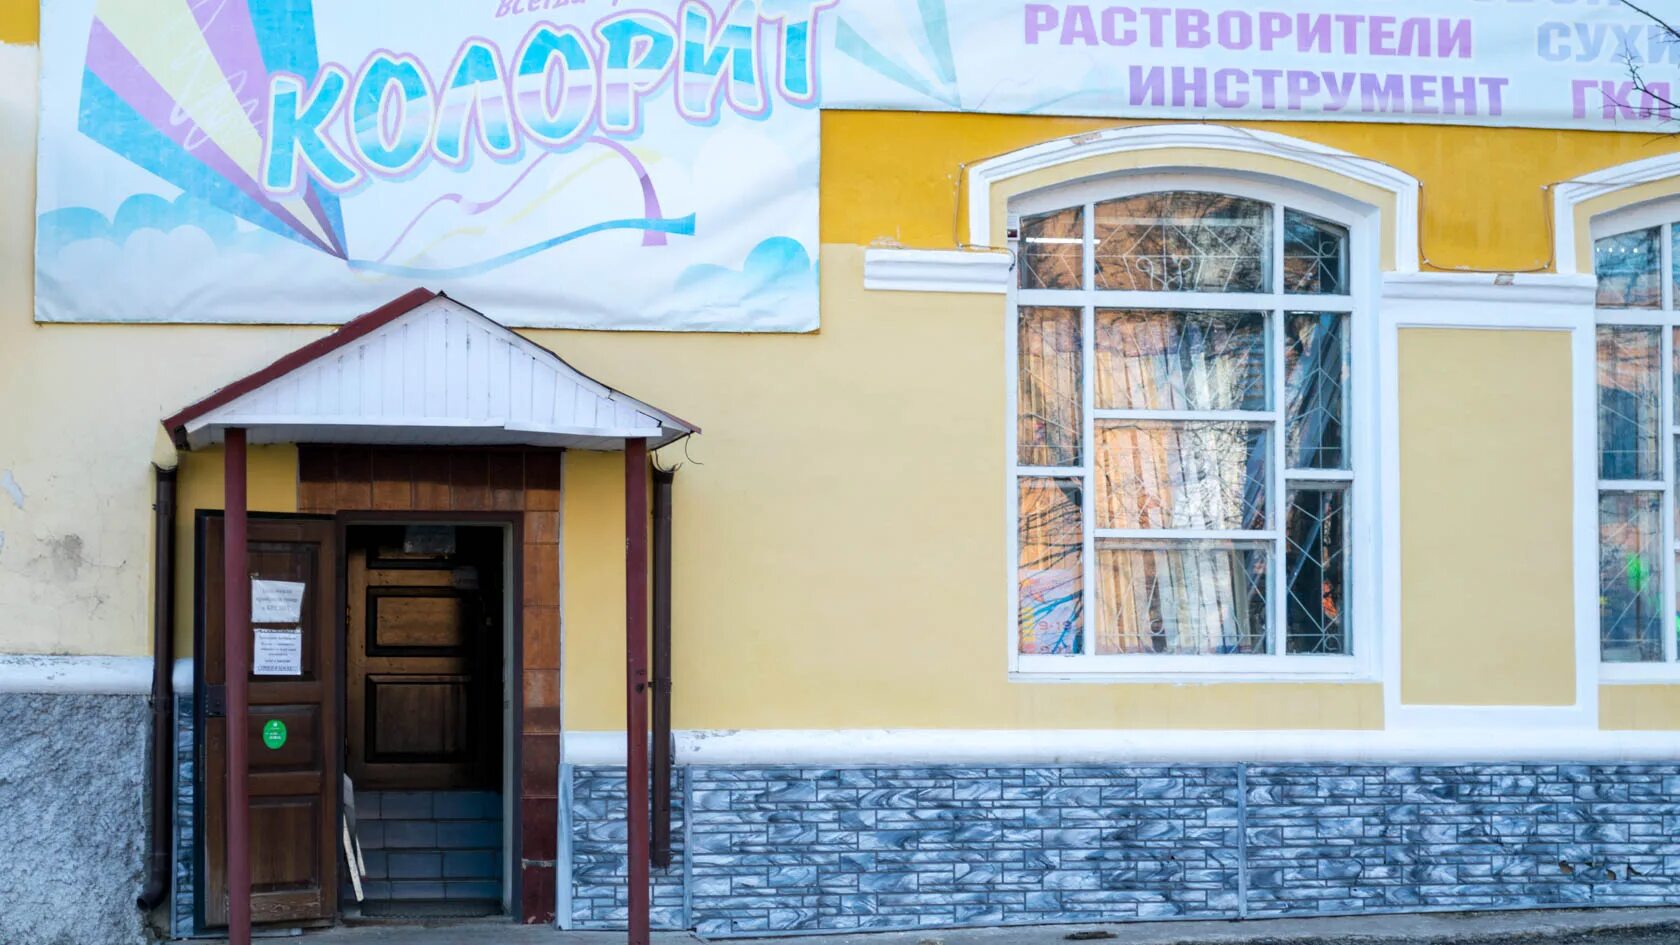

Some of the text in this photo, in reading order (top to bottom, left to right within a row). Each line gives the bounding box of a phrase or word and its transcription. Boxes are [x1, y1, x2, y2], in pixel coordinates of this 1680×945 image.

[1024, 4, 1472, 58] РАСТВОРИТЕЛИ
[259, 0, 839, 196] КОЛОРИТ
[1128, 65, 1509, 116] ИНСТРУМЕНТ
[1571, 79, 1672, 121] ГКЛ
